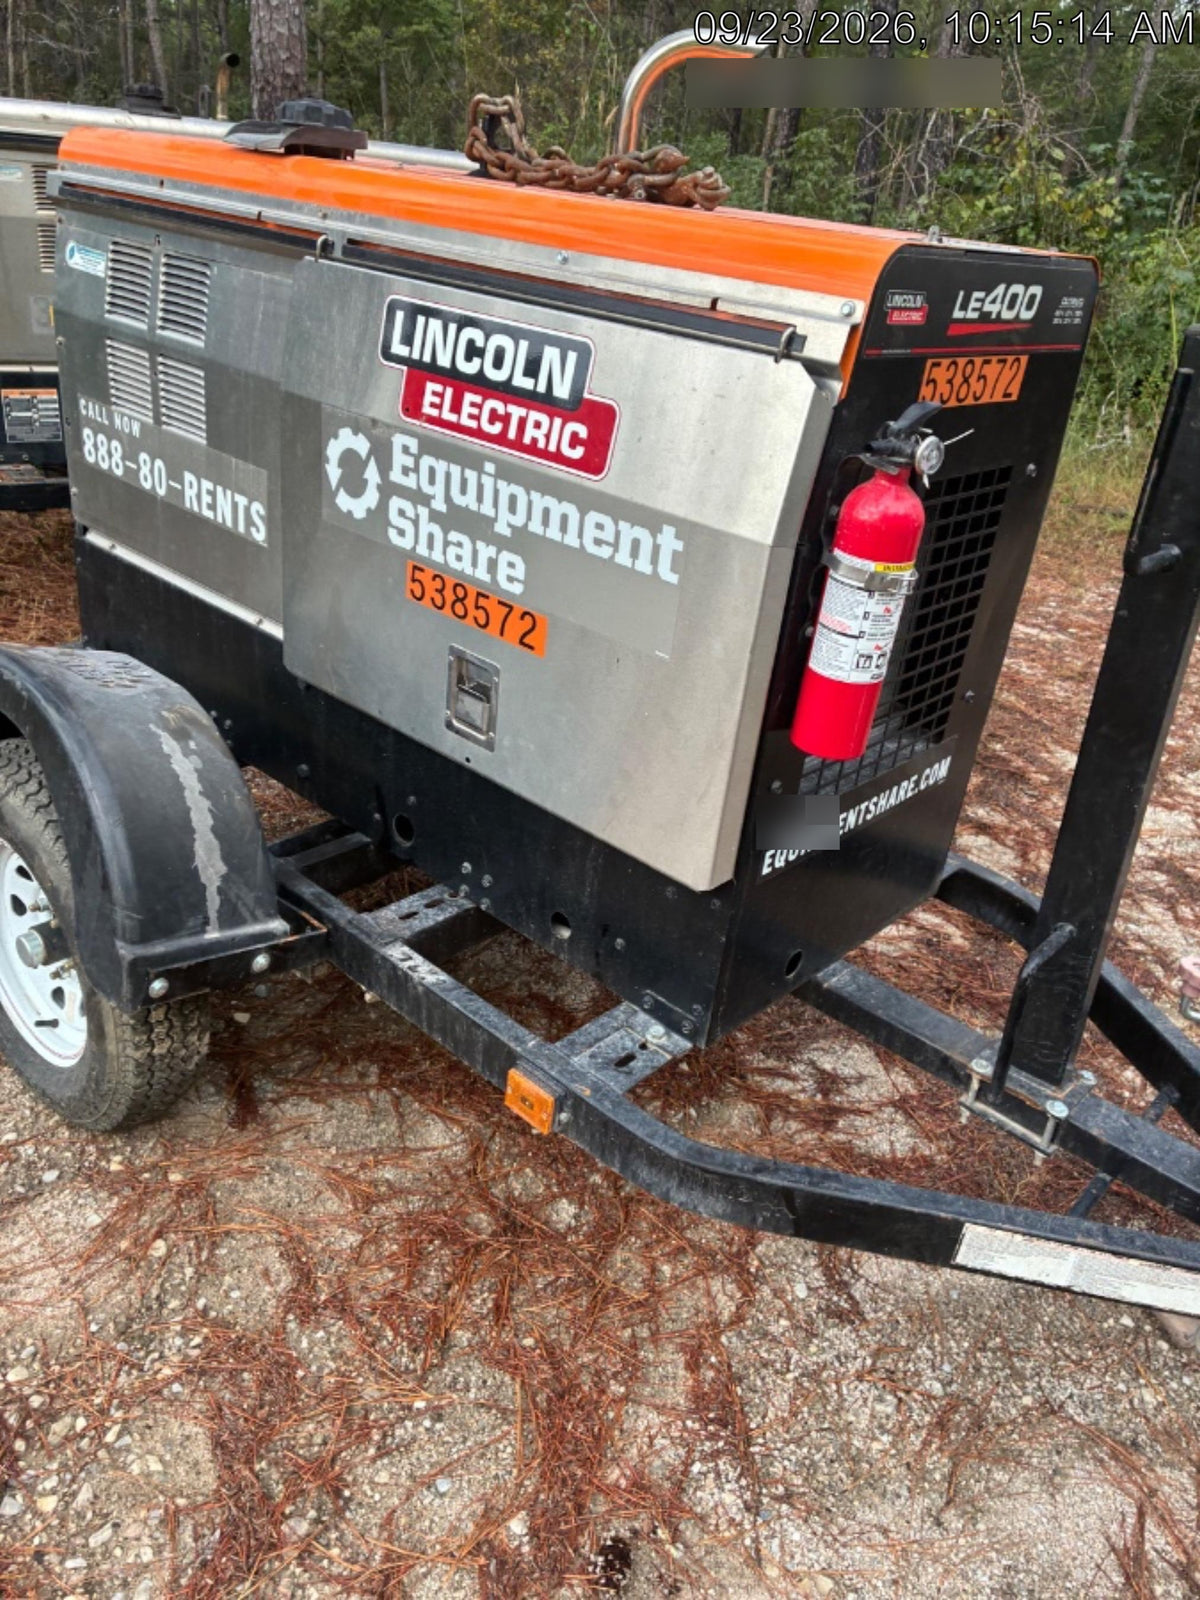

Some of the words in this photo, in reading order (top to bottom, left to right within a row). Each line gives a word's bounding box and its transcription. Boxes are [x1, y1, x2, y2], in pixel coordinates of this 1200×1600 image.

[887, 294, 923, 308] LINCOLN
[952, 283, 1043, 320] LE400
[390, 310, 578, 400] LINCOLN
[921, 357, 1021, 406] 538572
[79, 398, 109, 425] CALL
[114, 412, 141, 438] NOW
[421, 381, 589, 459] ELECTRIC
[82, 427, 266, 542] 888-80-RENTS
[389, 433, 684, 585] Equipment
[387, 496, 526, 595] Share
[409, 564, 538, 652] 538572
